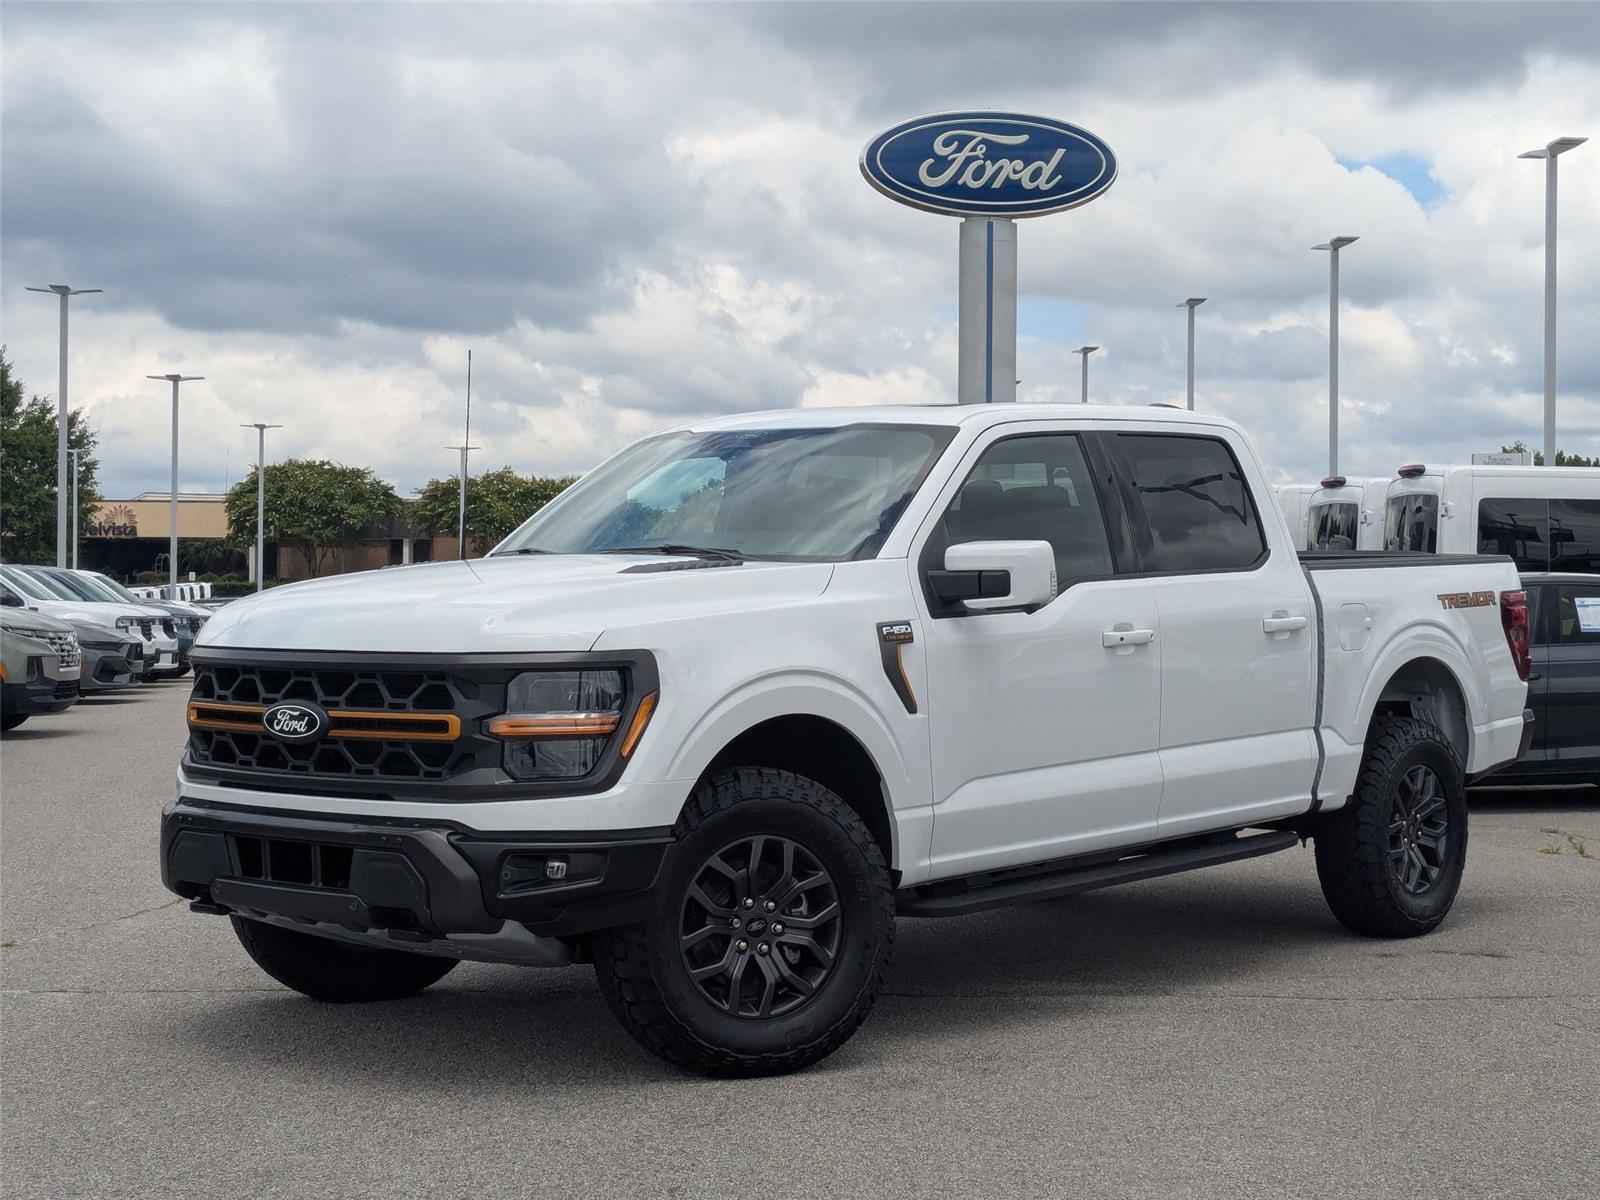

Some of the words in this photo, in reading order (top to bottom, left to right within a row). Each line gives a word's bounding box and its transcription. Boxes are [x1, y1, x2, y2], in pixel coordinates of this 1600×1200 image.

[918, 129, 1067, 191] Ford
[84, 521, 138, 537] elvista
[1436, 590, 1497, 609] TREMOR
[273, 709, 309, 732] Ford
